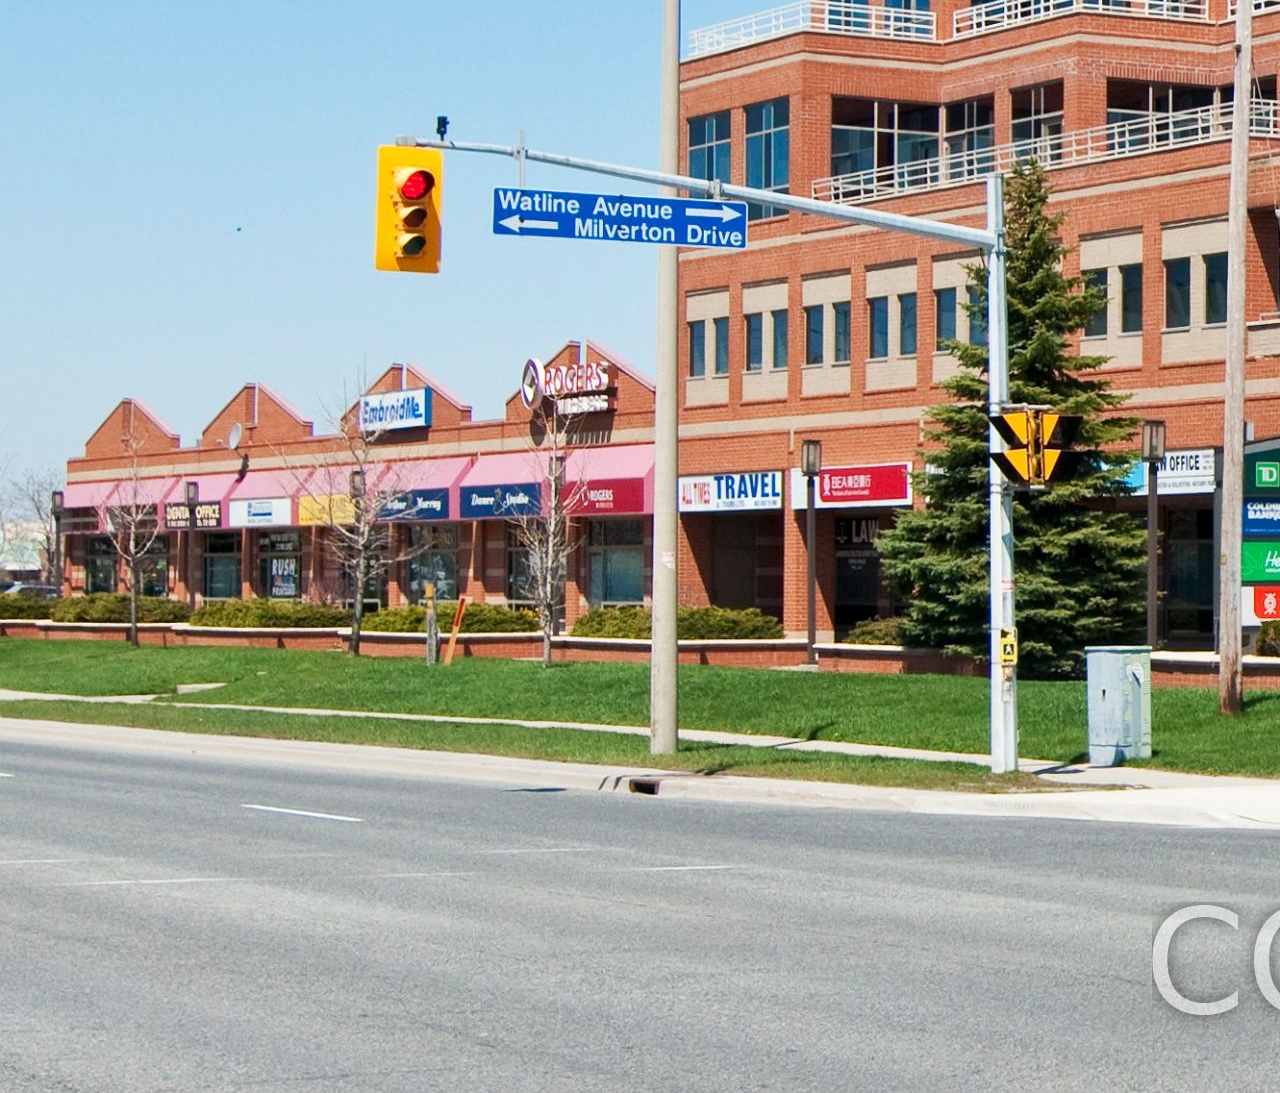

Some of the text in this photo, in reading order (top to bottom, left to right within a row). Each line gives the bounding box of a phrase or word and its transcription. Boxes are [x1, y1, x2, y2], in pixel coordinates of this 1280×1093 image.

[498, 190, 673, 219] Watline Avenue
[574, 218, 742, 246] Milverton Drive
[544, 362, 609, 394] ROGERS
[364, 396, 423, 423] EmbroidMe
[1169, 455, 1200, 471] OFFICE
[831, 476, 848, 489] BEA
[1258, 466, 1278, 483] TD
[714, 473, 780, 500] TRAVEL
[167, 504, 219, 520] DENTA OFFICE
[271, 558, 296, 576] RUSH
